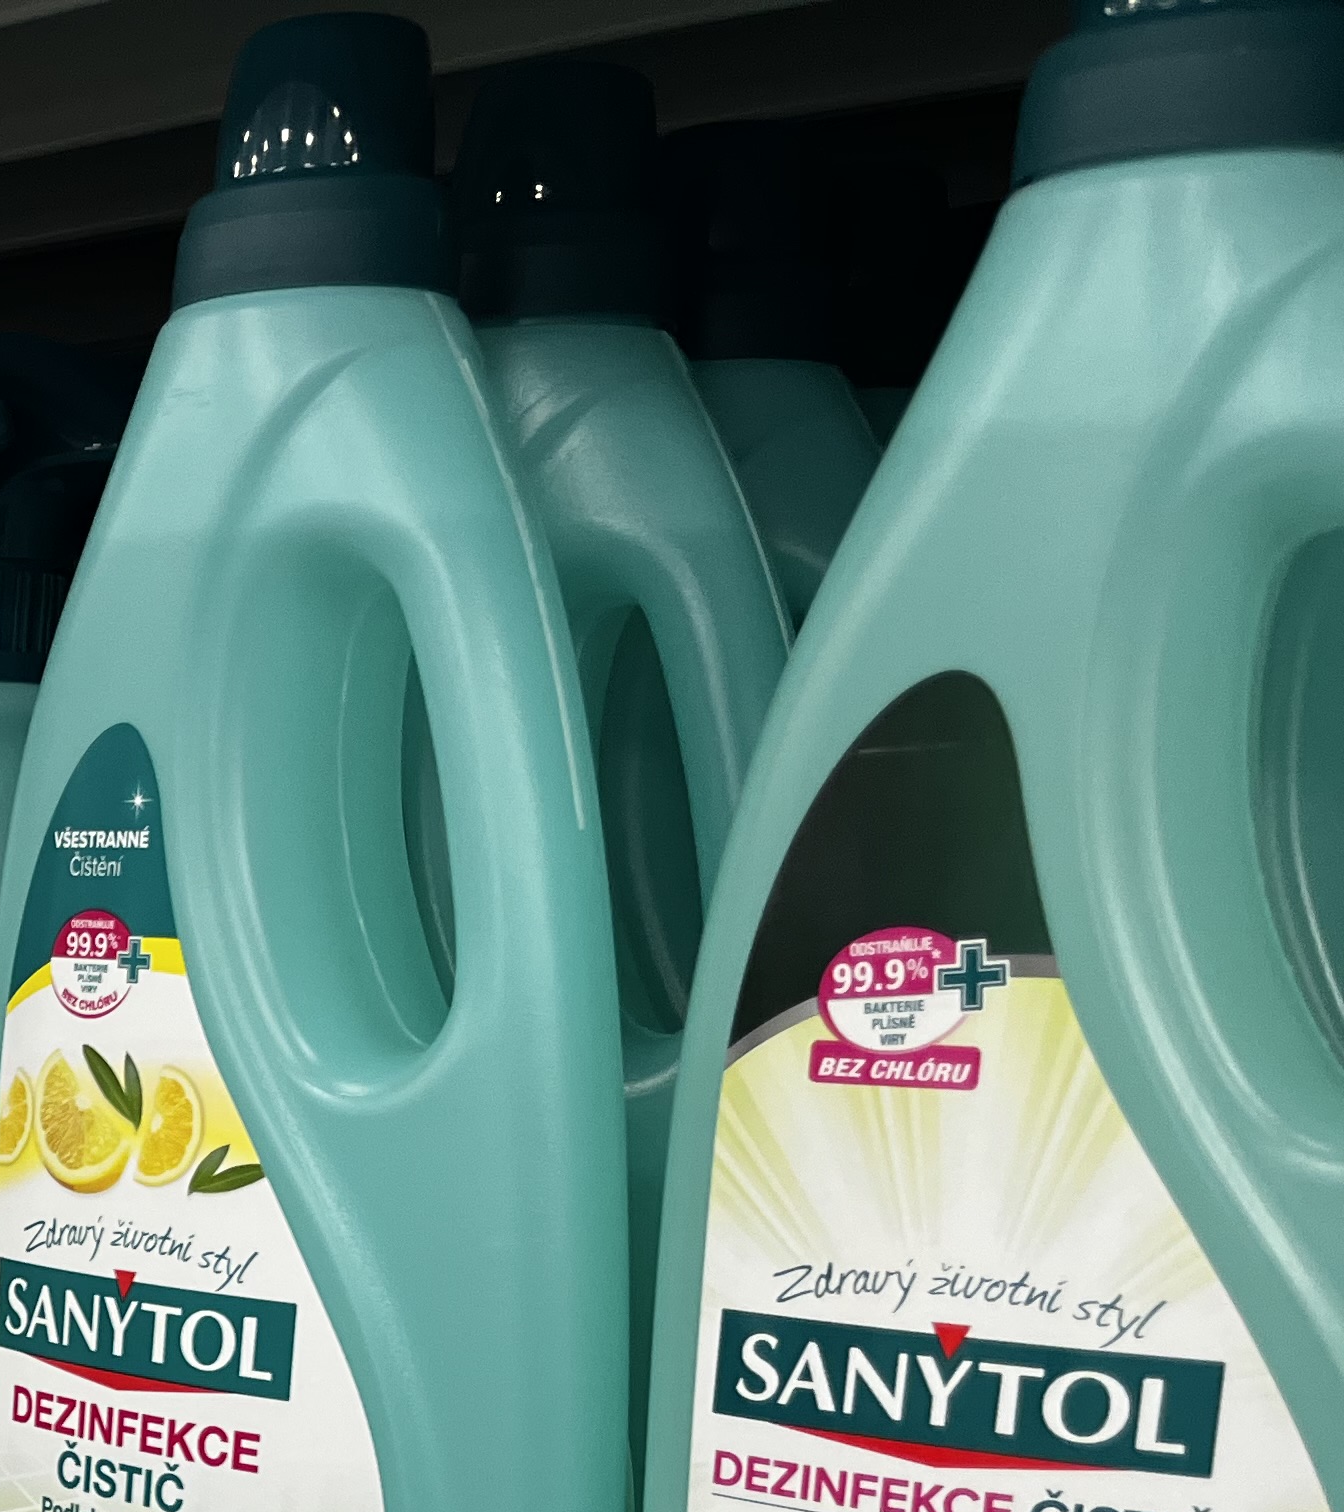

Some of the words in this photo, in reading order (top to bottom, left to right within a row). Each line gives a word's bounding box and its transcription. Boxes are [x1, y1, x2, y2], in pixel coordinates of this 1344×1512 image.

[54, 828, 150, 851] VŠESTRANNÉ
[69, 851, 122, 878] Čištění
[864, 998, 925, 1016] BAKTERIE
[879, 1032, 907, 1046] VIRY
[818, 1056, 861, 1079] BEZ
[868, 1053, 970, 1085] CHLÓRU
[23, 1216, 106, 1262] Zdravý
[198, 1249, 259, 1291] styl
[5, 1276, 273, 1383] SANYTOL
[773, 1260, 916, 1311] Zdravý
[927, 1262, 1064, 1313] životní
[1072, 1296, 1167, 1348] styl
[735, 1334, 1187, 1456] SANYTOL
[12, 1384, 261, 1474] DEZINFEKCE
